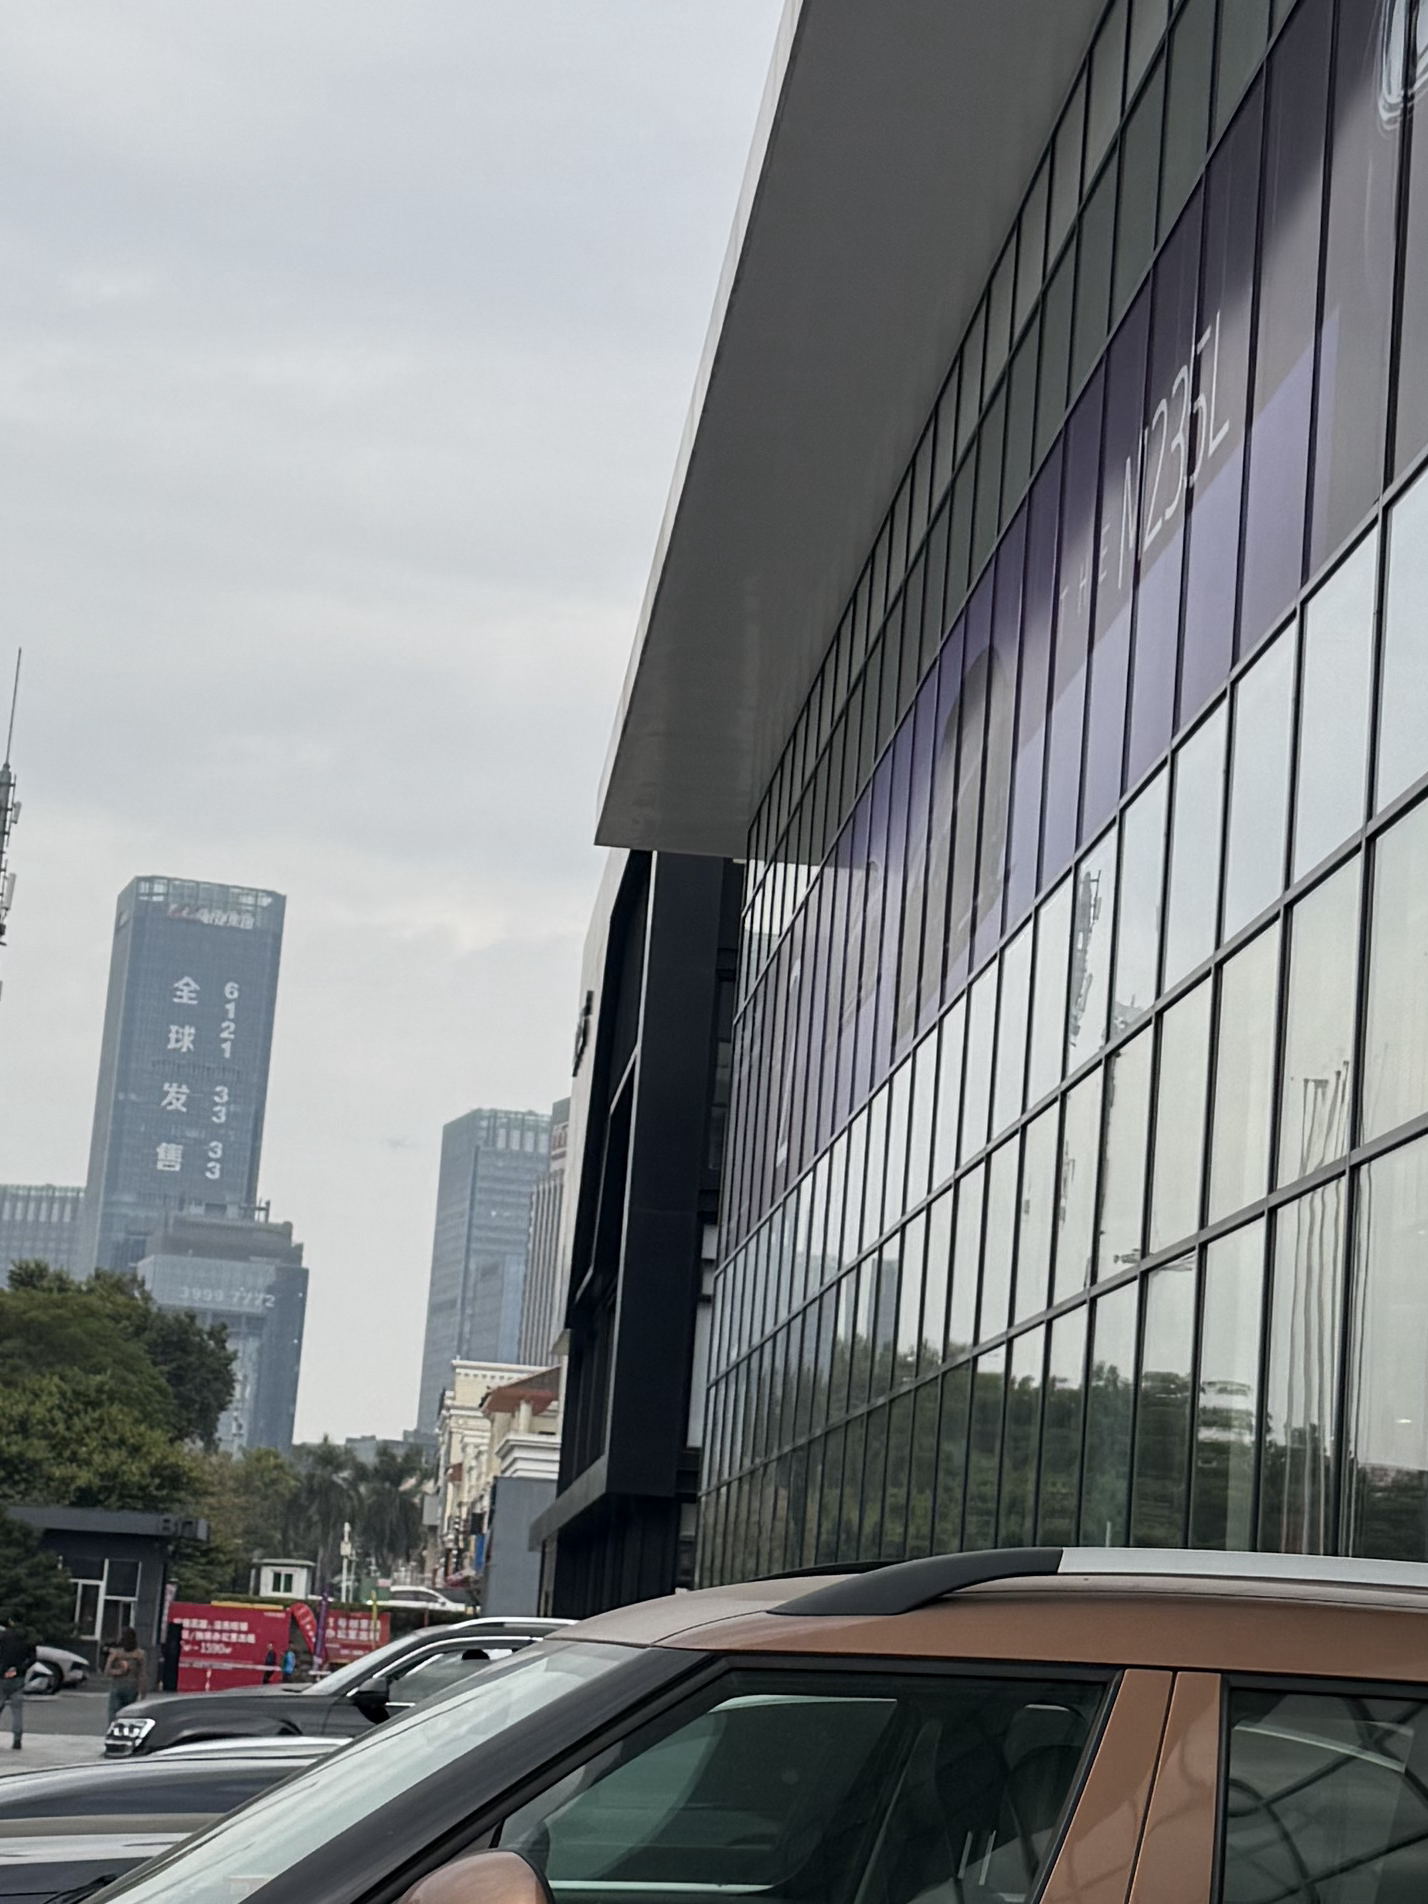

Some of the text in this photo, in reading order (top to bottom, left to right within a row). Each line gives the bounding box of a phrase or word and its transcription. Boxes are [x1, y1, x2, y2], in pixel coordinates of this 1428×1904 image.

[1058, 522, 1110, 643] THE
[155, 975, 201, 1172] 全球发售
